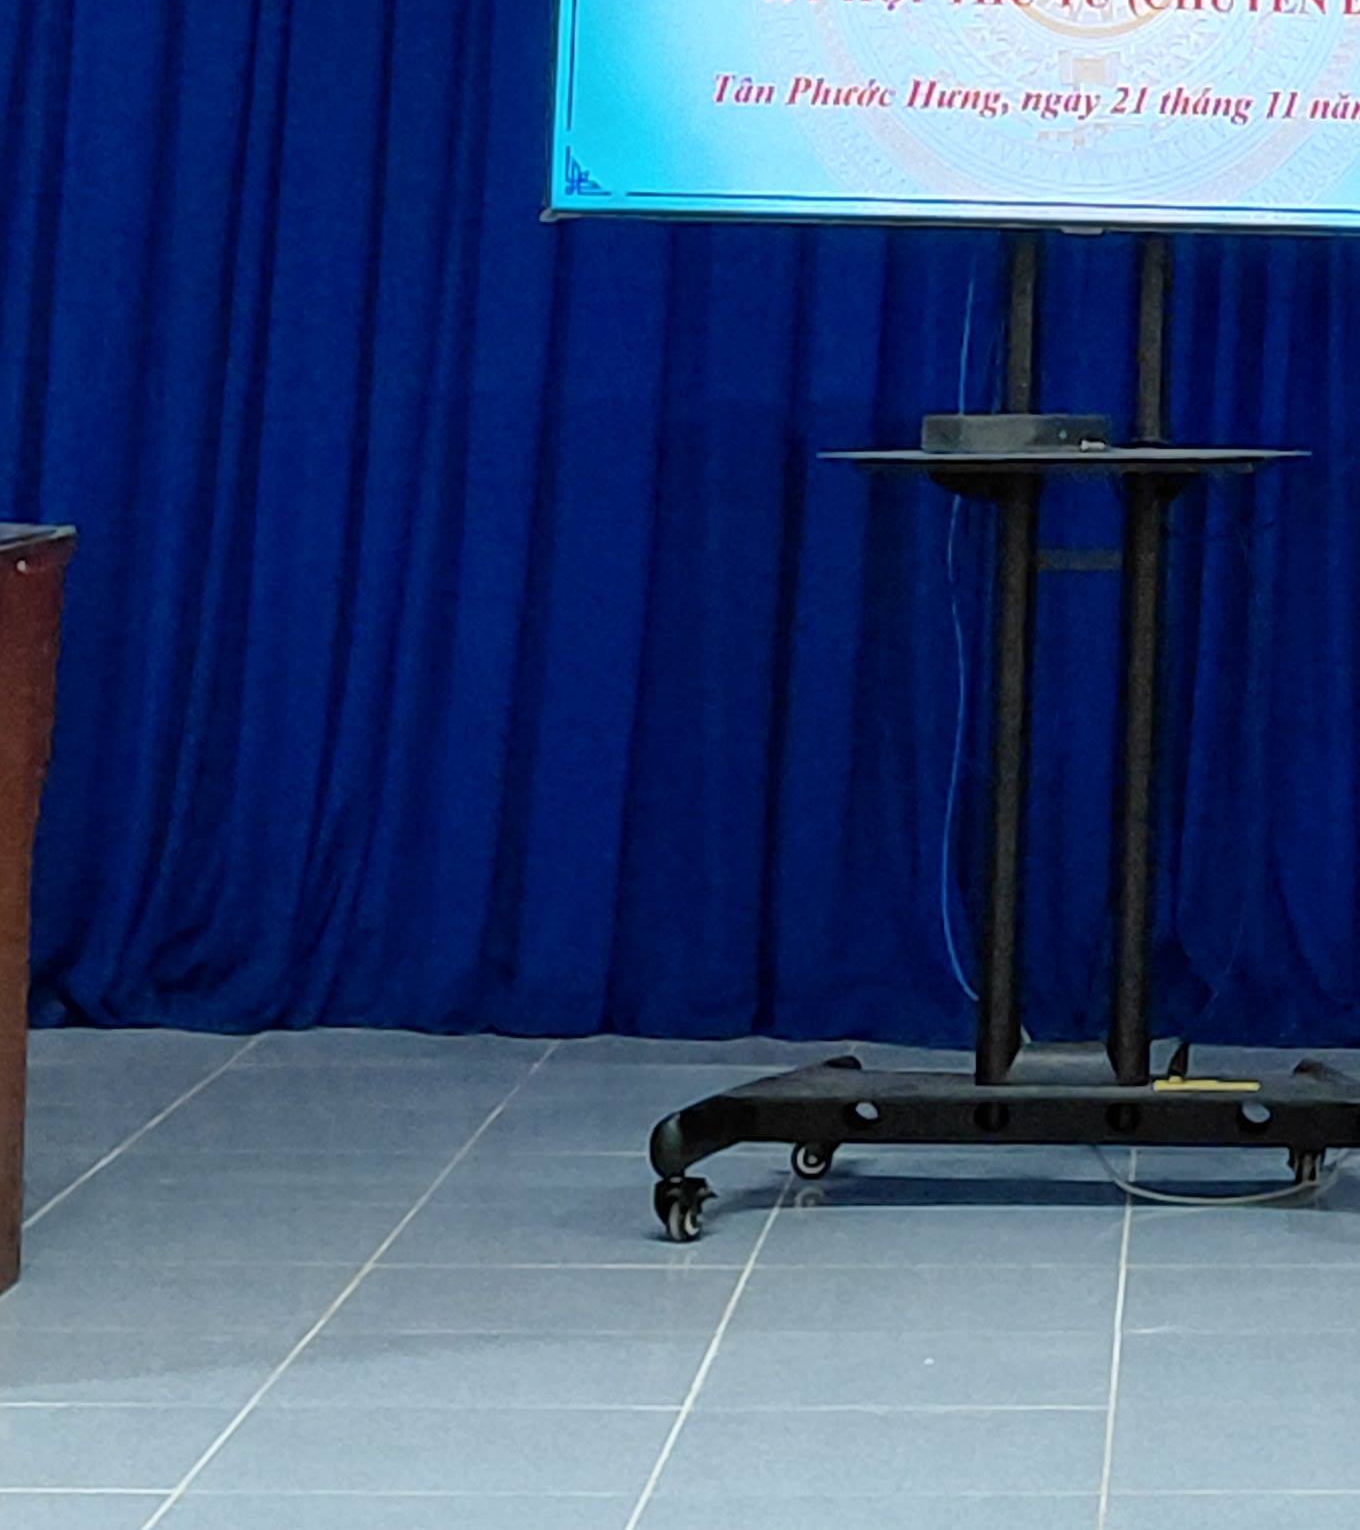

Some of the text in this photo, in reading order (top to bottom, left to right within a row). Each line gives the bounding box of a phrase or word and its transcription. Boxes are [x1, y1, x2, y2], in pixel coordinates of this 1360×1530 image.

[714, 73, 776, 105] Tân
[784, 76, 897, 108] Phước
[905, 78, 1010, 119] Hưng,
[1110, 86, 1149, 115] 21
[1158, 86, 1254, 126] tháng
[1265, 90, 1299, 121] 11
